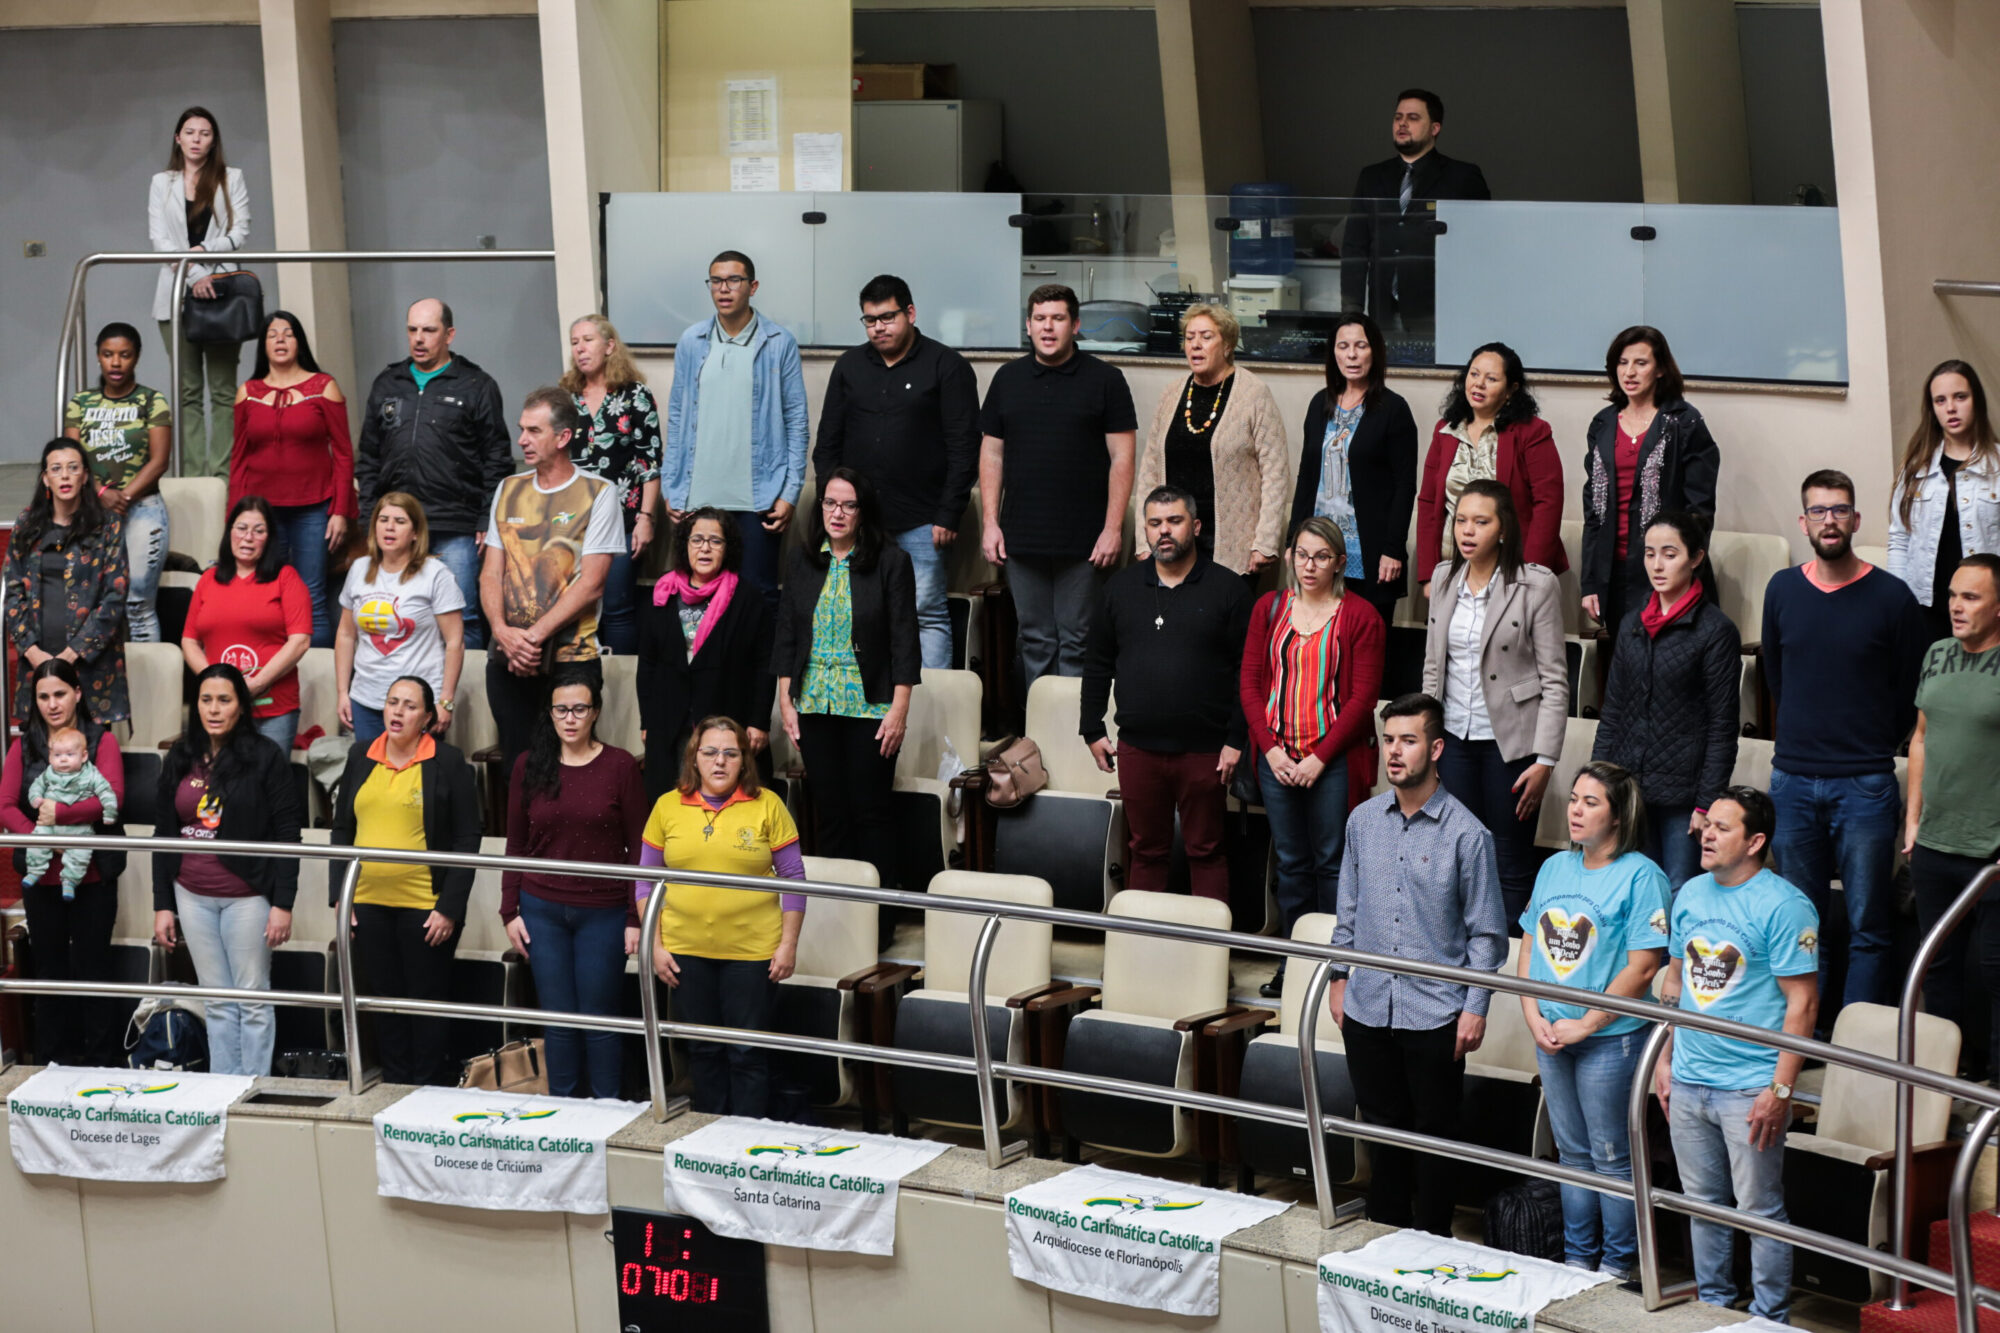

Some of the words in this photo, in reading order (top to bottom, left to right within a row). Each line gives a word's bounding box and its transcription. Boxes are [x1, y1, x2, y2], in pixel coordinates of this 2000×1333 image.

[87, 429, 126, 448] JESUS
[1561, 939, 1581, 950] Sonho
[1703, 968, 1726, 979] Sonho
[11, 1100, 81, 1121] Renovação
[85, 1106, 161, 1124] Carismática
[165, 1110, 220, 1127] Católica
[70, 1129, 113, 1143] Diocese
[115, 1132, 128, 1143] de
[131, 1133, 160, 1146] Lages
[383, 1124, 455, 1147] Renovação
[458, 1132, 534, 1151] Carismática
[538, 1136, 593, 1153] Católica
[434, 1155, 478, 1170] Diocese
[481, 1159, 493, 1171] de
[497, 1160, 542, 1173] Criciúma
[674, 1153, 746, 1179] Renovação
[749, 1165, 825, 1188] Carismática
[829, 1174, 885, 1194] Católica
[734, 1187, 769, 1204] Santa
[773, 1192, 821, 1211] Catarina
[1008, 1197, 1077, 1229] Renovação
[1081, 1215, 1155, 1244] Carismática
[1159, 1230, 1214, 1253] Católica
[1033, 1231, 1101, 1257] Arquidiocese
[1116, 1250, 1183, 1273] Florianópolis
[1319, 1265, 1389, 1298] Renovação
[1392, 1285, 1469, 1320] Carismática
[1473, 1305, 1528, 1329] Católica
[1371, 1306, 1412, 1330] Diocese
[1415, 1320, 1428, 1333] de
